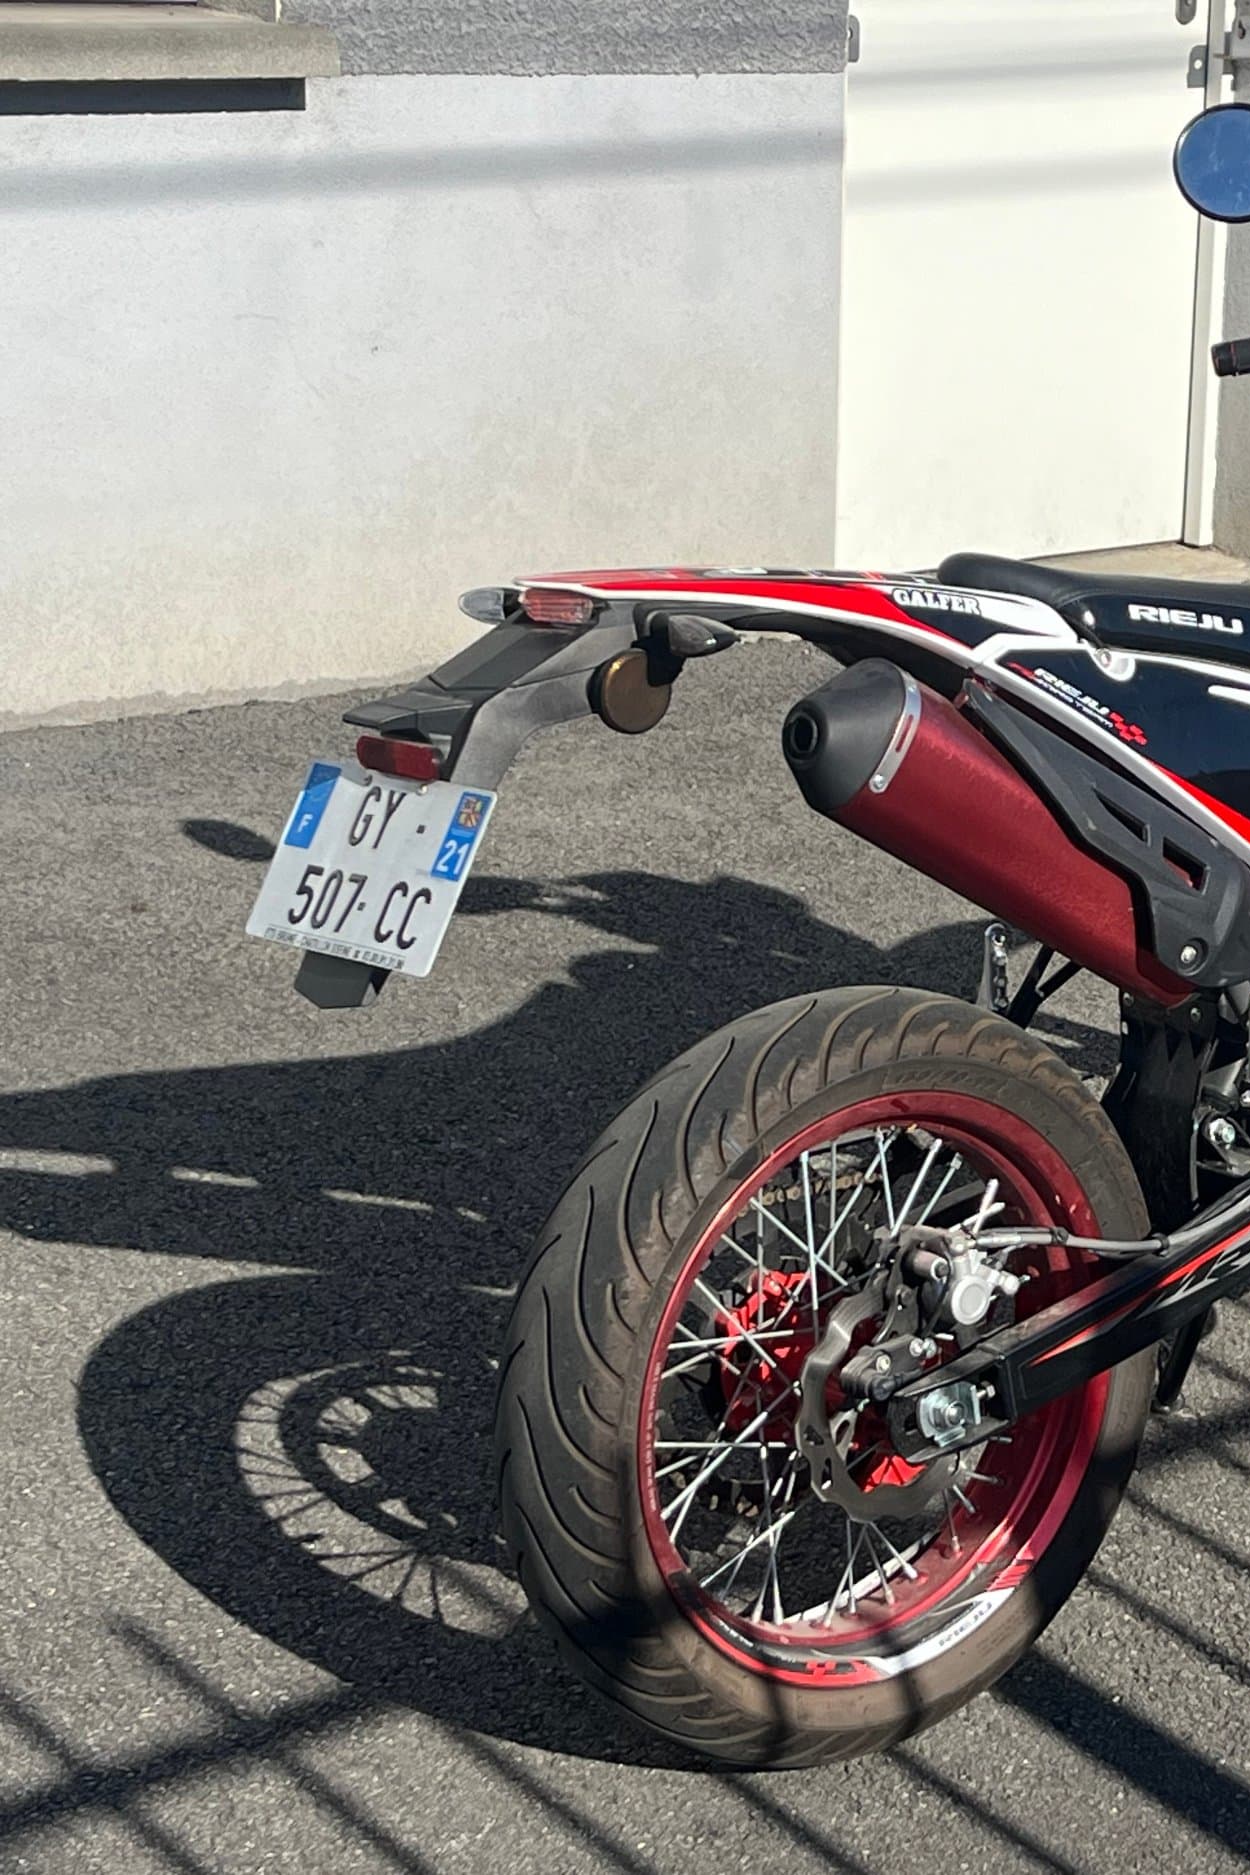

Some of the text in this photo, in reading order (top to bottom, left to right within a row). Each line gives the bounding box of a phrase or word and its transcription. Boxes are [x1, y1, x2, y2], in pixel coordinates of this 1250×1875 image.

[893, 588, 982, 616] GALFER
[1128, 603, 1244, 635] RIEJU
[297, 813, 313, 834] F
[435, 840, 468, 875] 21
